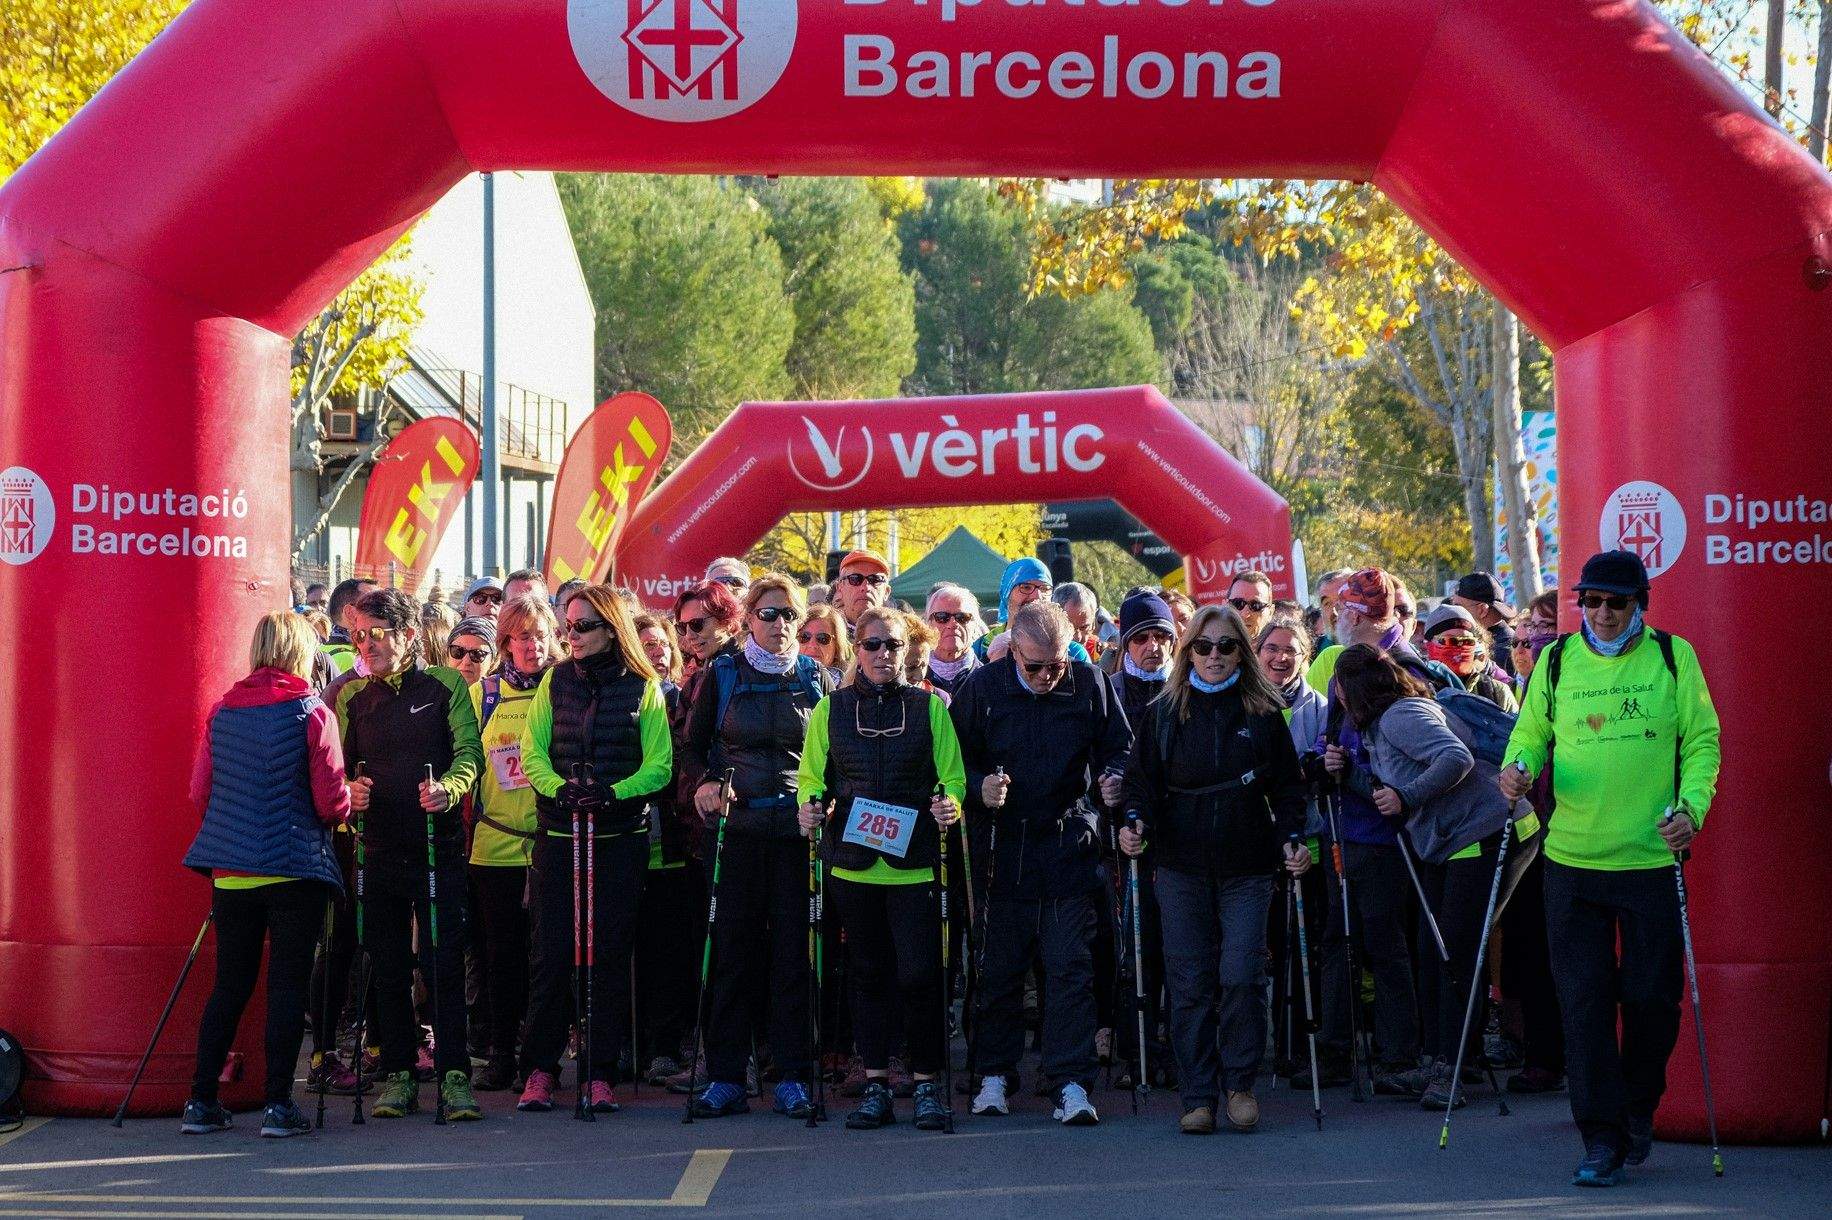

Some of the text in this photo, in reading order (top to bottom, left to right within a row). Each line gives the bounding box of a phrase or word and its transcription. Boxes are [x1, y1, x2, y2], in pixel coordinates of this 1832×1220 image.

[843, 34, 1281, 99] Barcelona
[889, 410, 1106, 479] vèrtic
[667, 456, 759, 544] www.verticoutdoor.com
[1137, 440, 1232, 524] www.verticoutdoor.com
[72, 483, 248, 521] Diputació
[374, 435, 466, 582] EKI
[1705, 493, 1832, 530] Diputa
[72, 524, 248, 558] Barcelona
[1220, 550, 1286, 577] vèrtic
[1582, 688, 1608, 699] Marxa
[1610, 686, 1621, 695] de
[1622, 685, 1631, 694] la
[1632, 683, 1654, 693] Salut
[857, 811, 901, 840] 285
